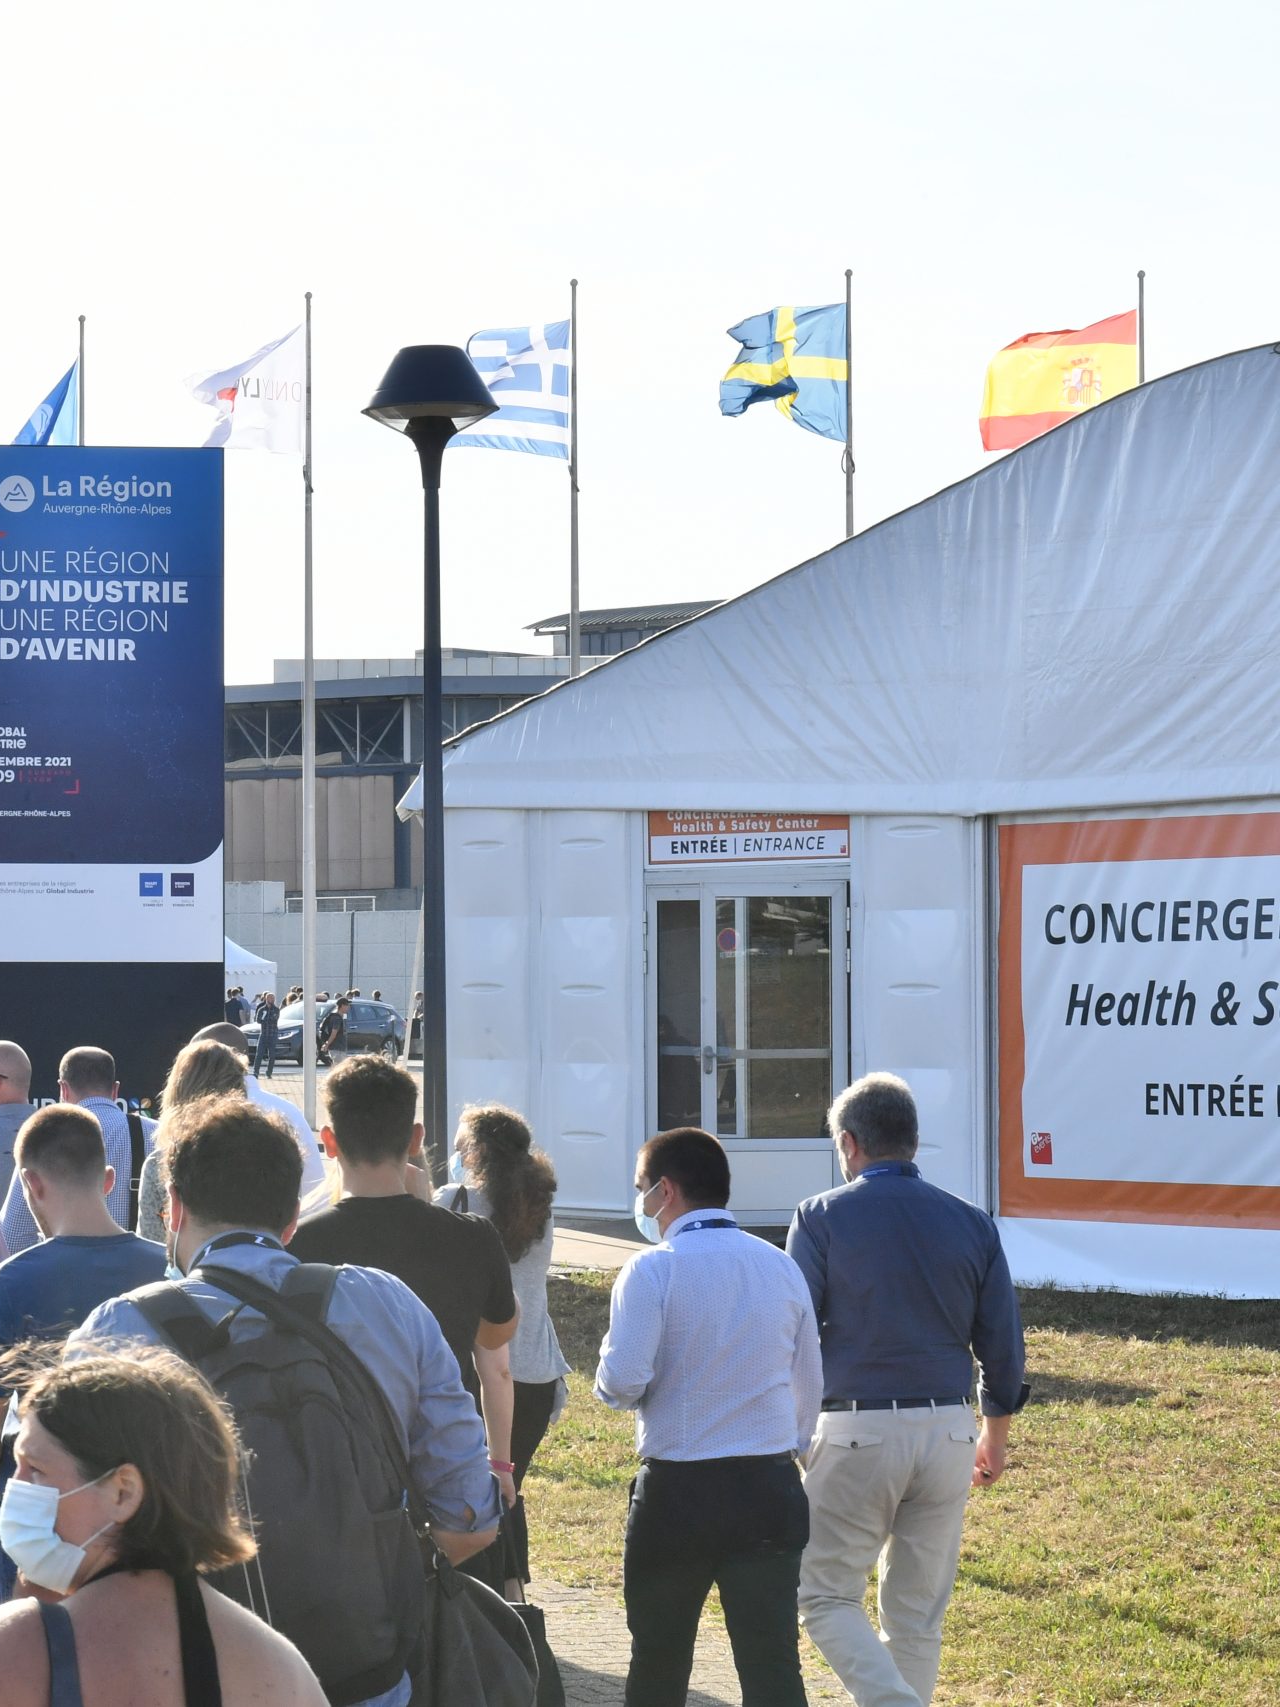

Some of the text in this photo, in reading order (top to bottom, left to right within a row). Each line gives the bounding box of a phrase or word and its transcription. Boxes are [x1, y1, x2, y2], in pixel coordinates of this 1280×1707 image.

[43, 474, 172, 502] La Région
[43, 503, 172, 516] Auvergne-Rhône-Alpes
[0, 546, 169, 574] UNE RÉGION
[0, 579, 189, 603] D'INDUSTRIE
[0, 604, 168, 632] UNE RÉGION
[0, 637, 136, 661] D'AVENIR
[44, 757, 72, 767] 2021
[673, 817, 820, 834] Health & Safety Center
[671, 836, 728, 855] ENTRÉE
[743, 836, 826, 853] ENTRANCE
[1044, 897, 1280, 946] CONCIERGE
[1065, 980, 1197, 1027] Health
[1210, 981, 1241, 1027] &
[1145, 1074, 1265, 1118] ENTRÉE
